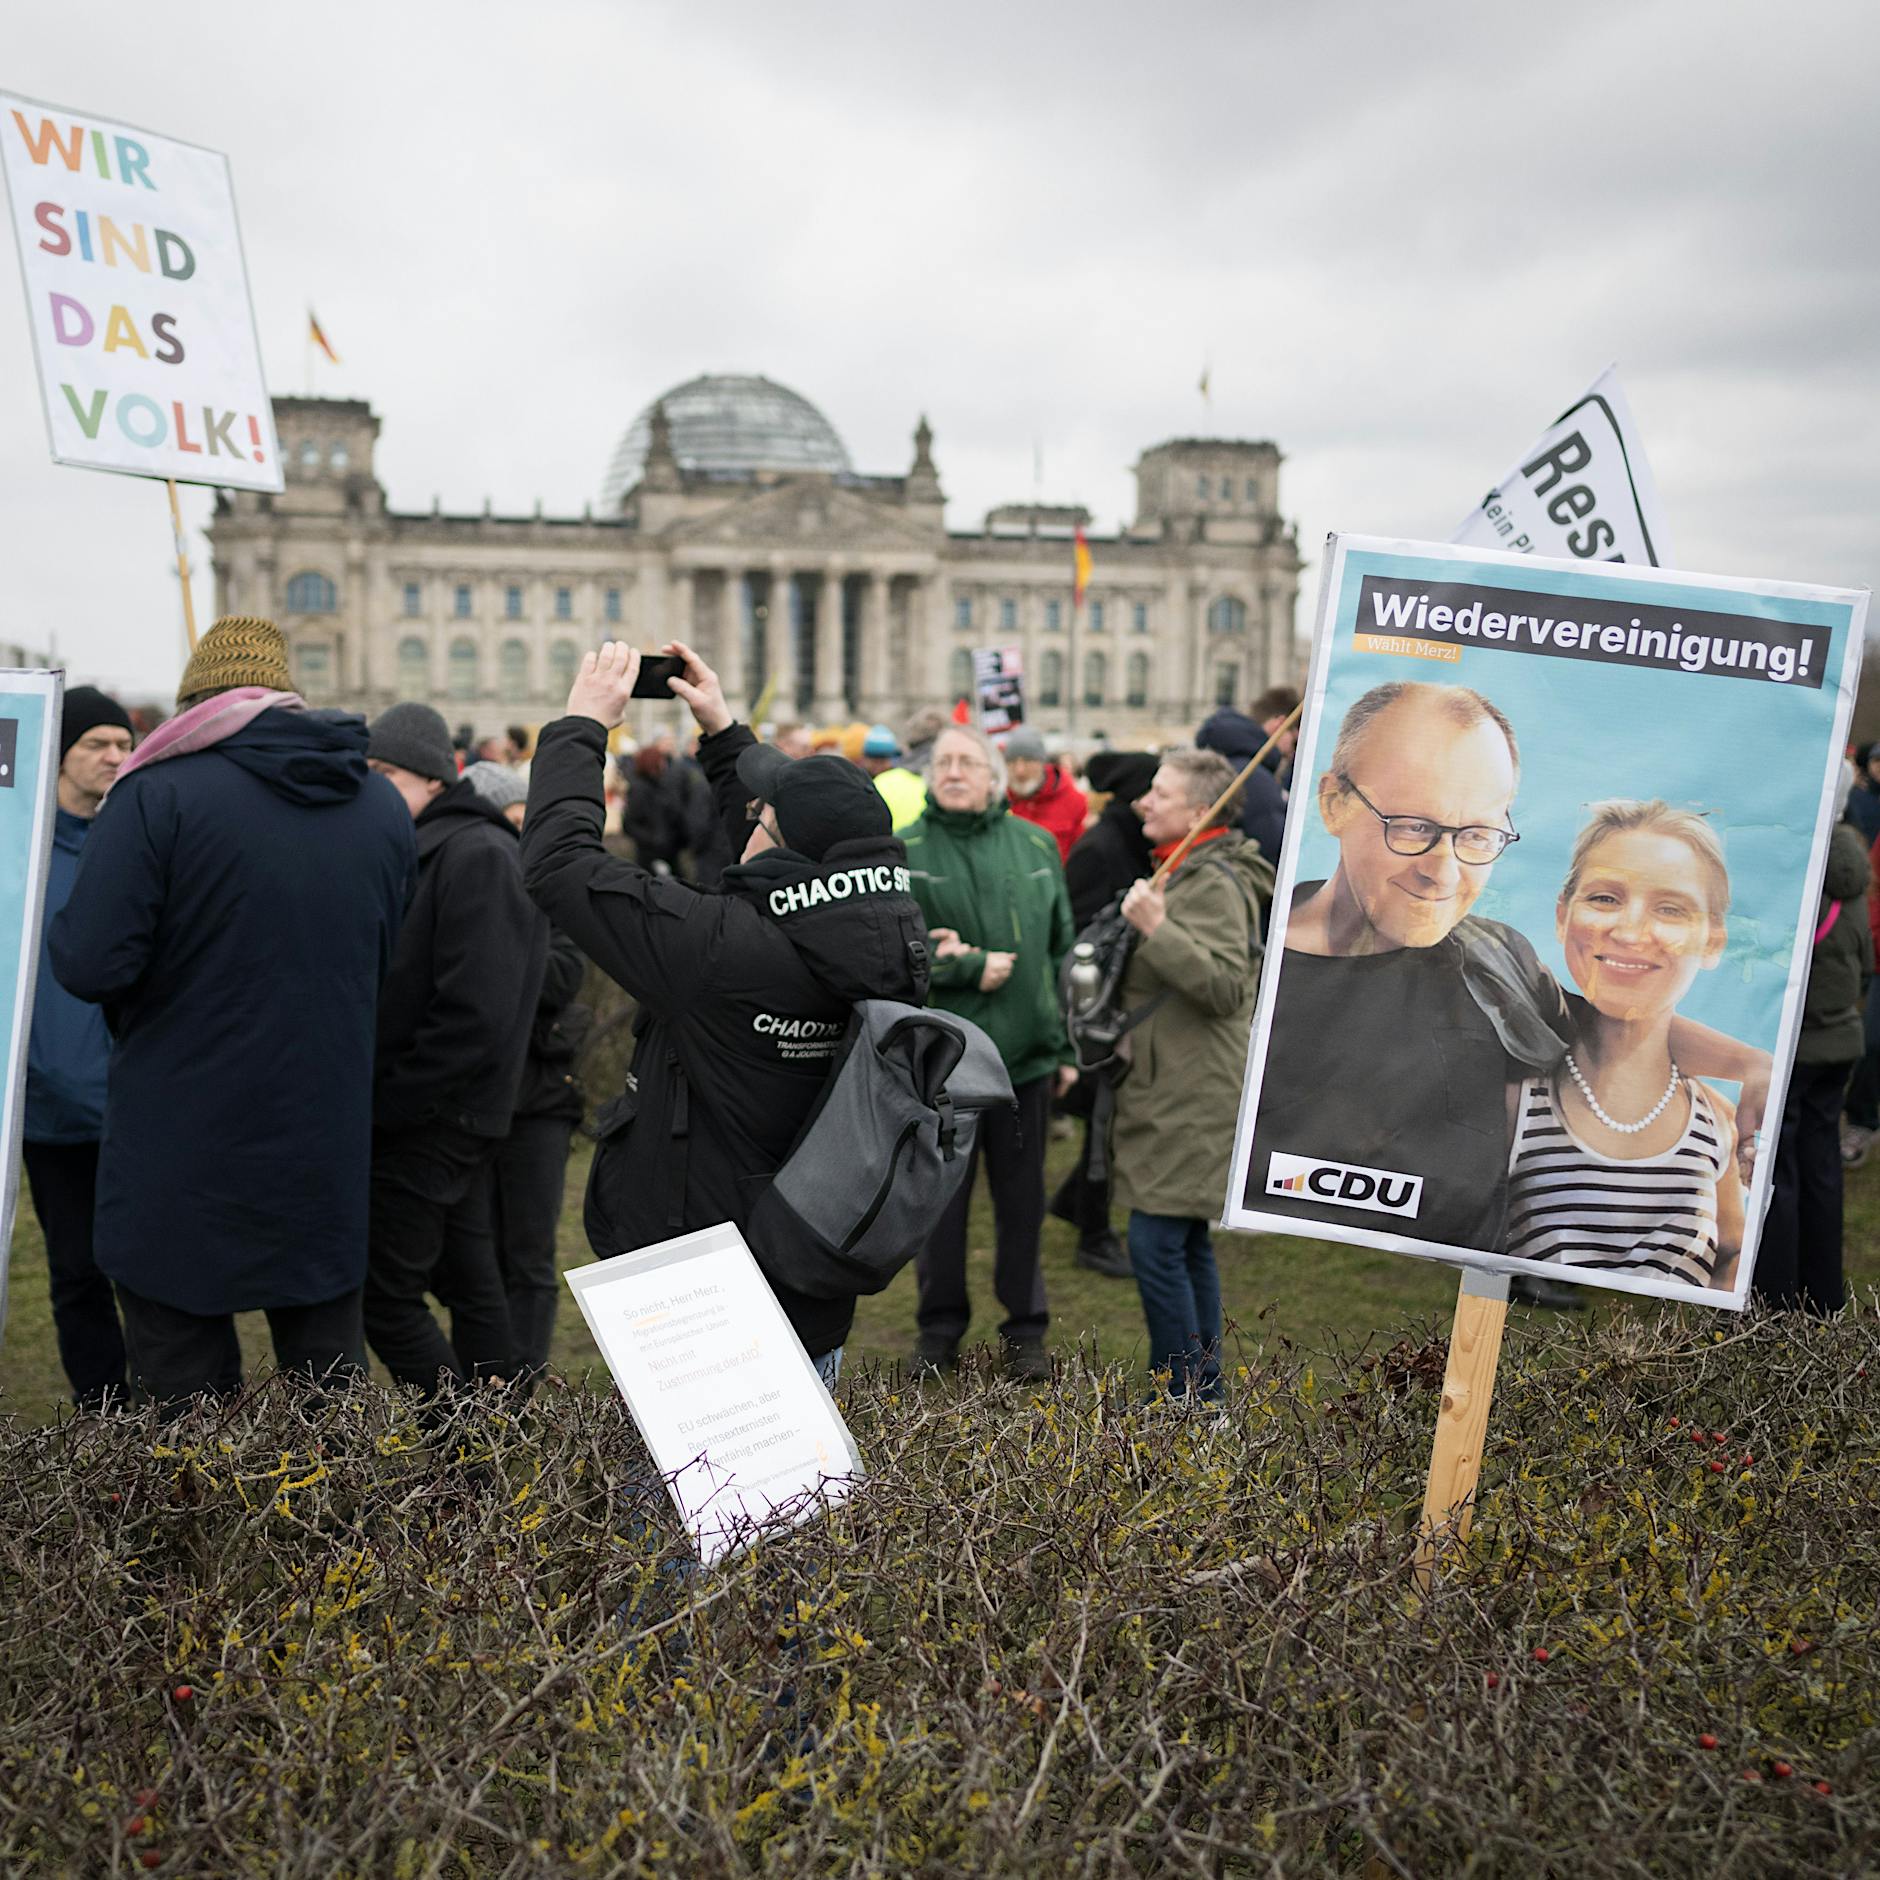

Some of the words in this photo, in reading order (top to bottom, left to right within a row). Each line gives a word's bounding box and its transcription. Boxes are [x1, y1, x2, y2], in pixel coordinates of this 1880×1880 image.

[11, 109, 158, 191] WIR
[34, 201, 196, 281] SIND
[49, 292, 185, 365] DAS
[60, 384, 265, 463] VOLK!
[1521, 430, 1626, 564] Res
[1367, 637, 1411, 653] Wählt
[1415, 642, 1457, 659] Merz!
[1372, 592, 1812, 682] Wiedervereinigung!
[769, 866, 893, 916] CHAOTIC
[753, 1013, 844, 1038] CHAOTIC
[1308, 1168, 1416, 1208] CDU
[623, 1309, 639, 1320] So
[640, 1301, 671, 1316] nicht,
[669, 1294, 693, 1306] Herr
[648, 1354, 677, 1372] Nicht
[679, 1349, 697, 1362] mit
[656, 1363, 724, 1392] Zustimmung
[723, 1355, 740, 1370] der
[678, 1420, 695, 1434] EU
[759, 1389, 782, 1403] aber
[752, 1431, 795, 1452] machen
